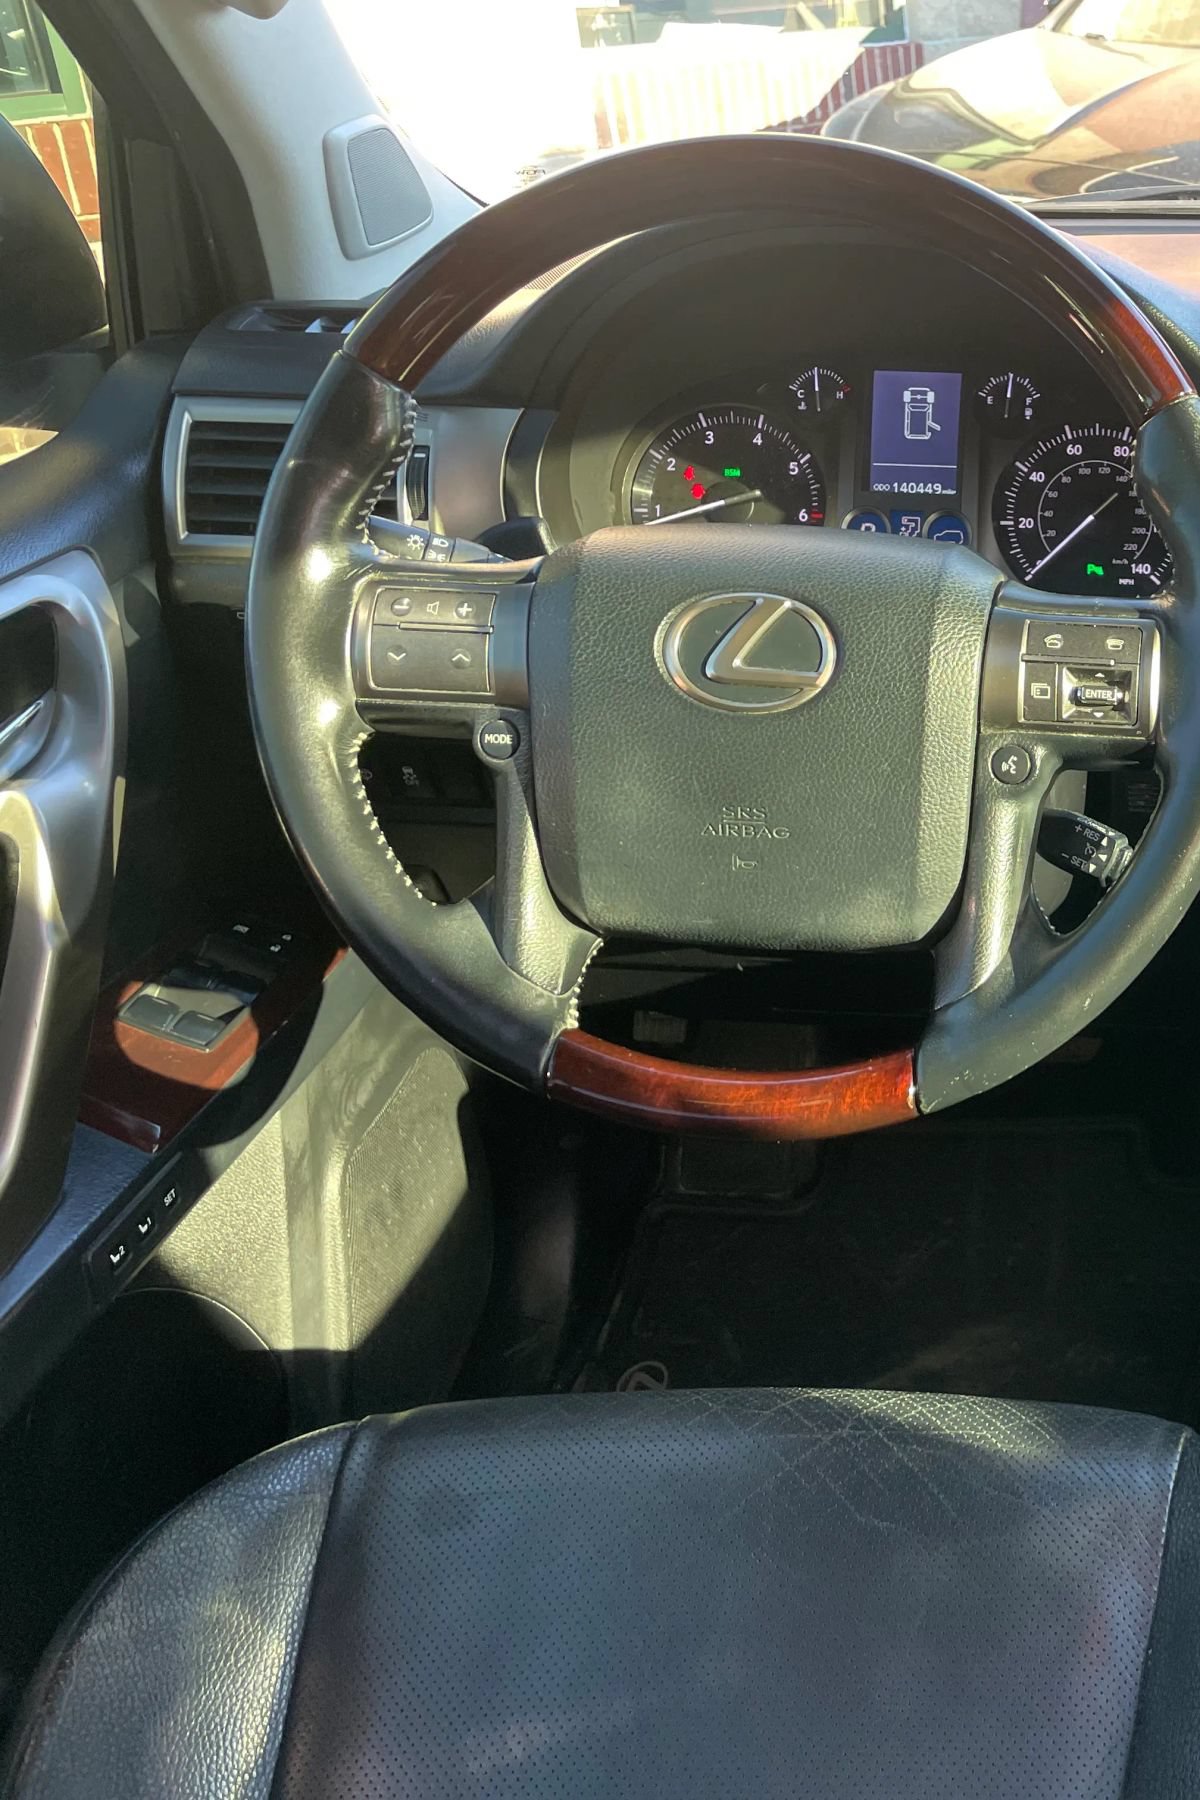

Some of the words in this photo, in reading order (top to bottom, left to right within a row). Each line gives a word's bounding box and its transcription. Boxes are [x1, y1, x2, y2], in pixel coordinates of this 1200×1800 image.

[836, 391, 844, 399] H
[704, 431, 714, 444] 3
[752, 433, 763, 445] 4
[1066, 444, 1083, 455] 60
[1113, 446, 1130, 457] 80
[667, 458, 676, 471] 2
[788, 462, 799, 475] 5
[1098, 466, 1111, 474] 120
[1028, 471, 1045, 482] 40
[1078, 467, 1091, 475] 100
[1061, 475, 1072, 483] 80
[893, 483, 942, 494] 140449
[1047, 490, 1058, 498] 60
[655, 504, 661, 517] 1
[798, 509, 808, 522] 6
[1042, 509, 1054, 517] 40
[1018, 518, 1034, 529] 20
[1046, 529, 1056, 537] 20
[1131, 526, 1146, 534] 200
[1131, 563, 1151, 575] 140
[1119, 578, 1135, 586] MPH
[1085, 689, 1113, 699] ENTER
[484, 733, 513, 743] MODE
[722, 806, 767, 819] SRS
[700, 823, 790, 839] AIRBAG
[1083, 827, 1100, 841] RES
[1070, 855, 1087, 870] SET
[163, 1188, 177, 1206] SET
